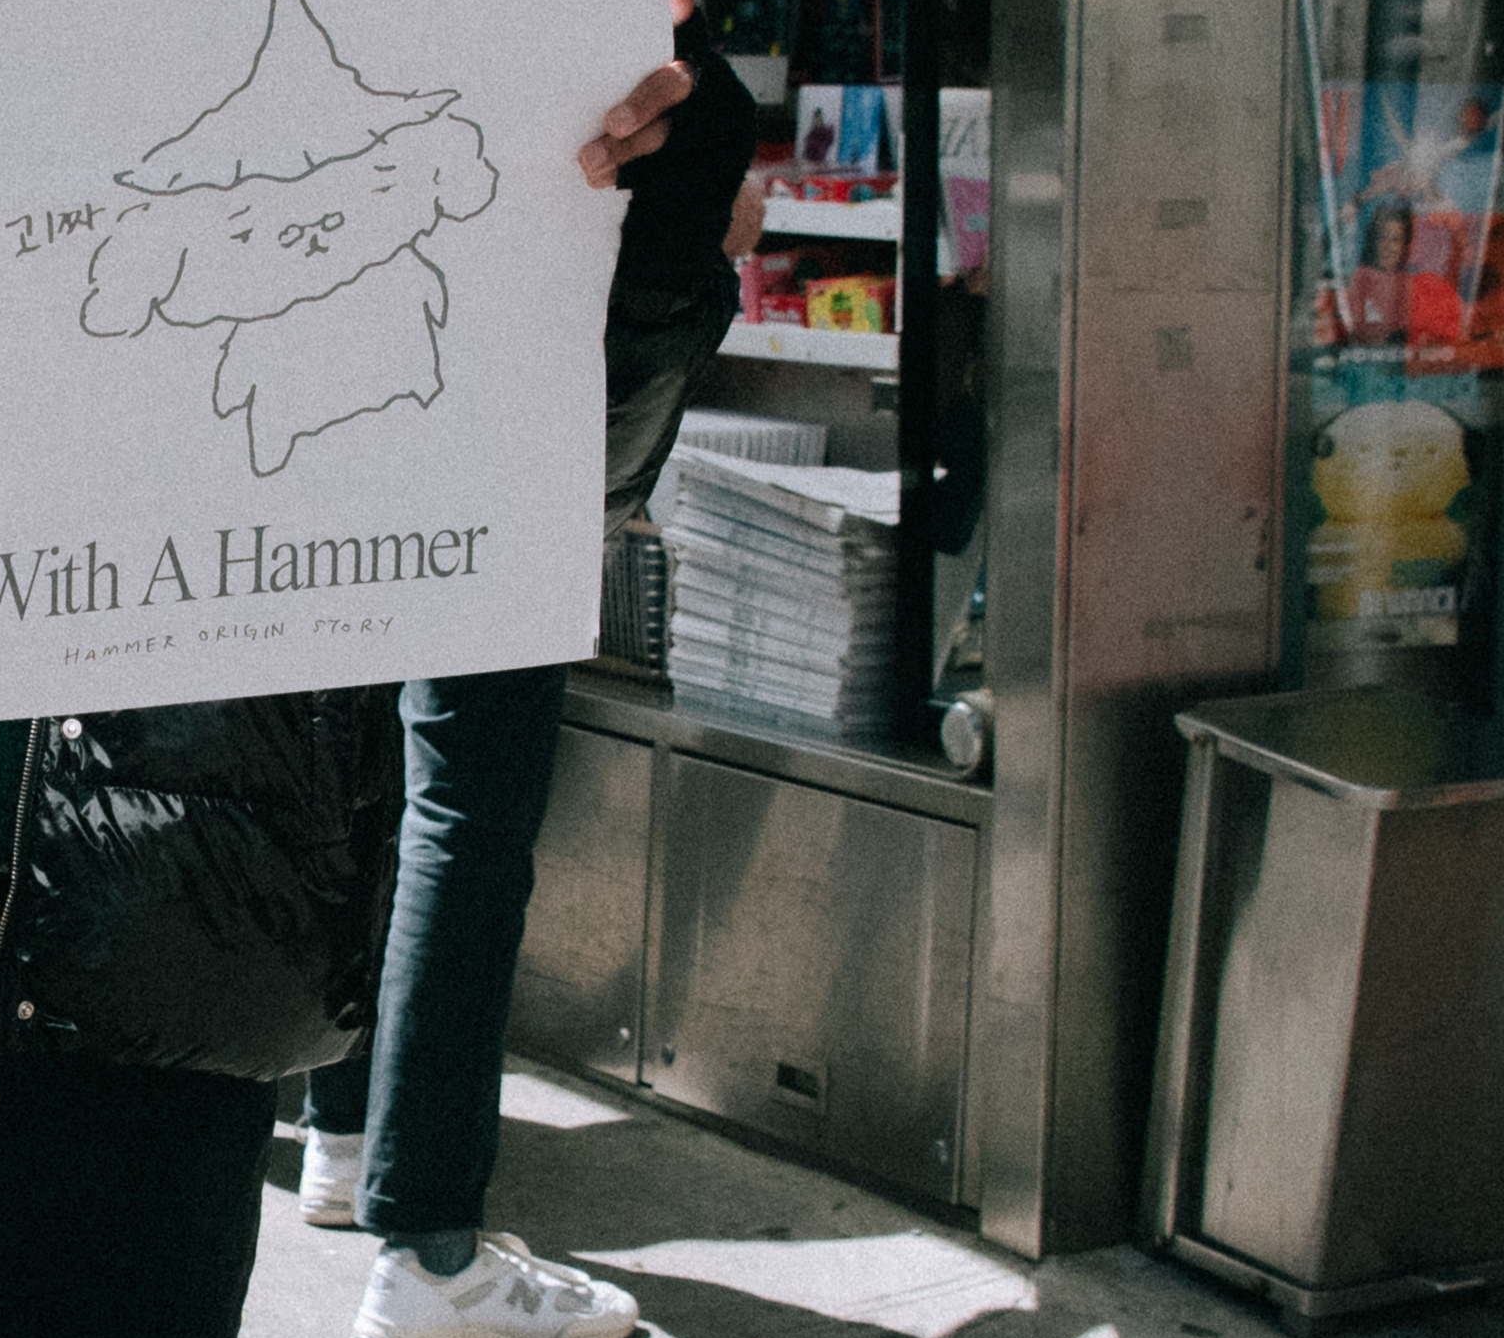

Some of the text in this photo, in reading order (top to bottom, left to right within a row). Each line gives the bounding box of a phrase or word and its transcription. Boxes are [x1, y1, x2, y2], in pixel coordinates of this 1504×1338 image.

[139, 534, 193, 608] A
[215, 524, 489, 598] Hammer
[63, 616, 394, 666] HAMMER ORIGIN STORY
